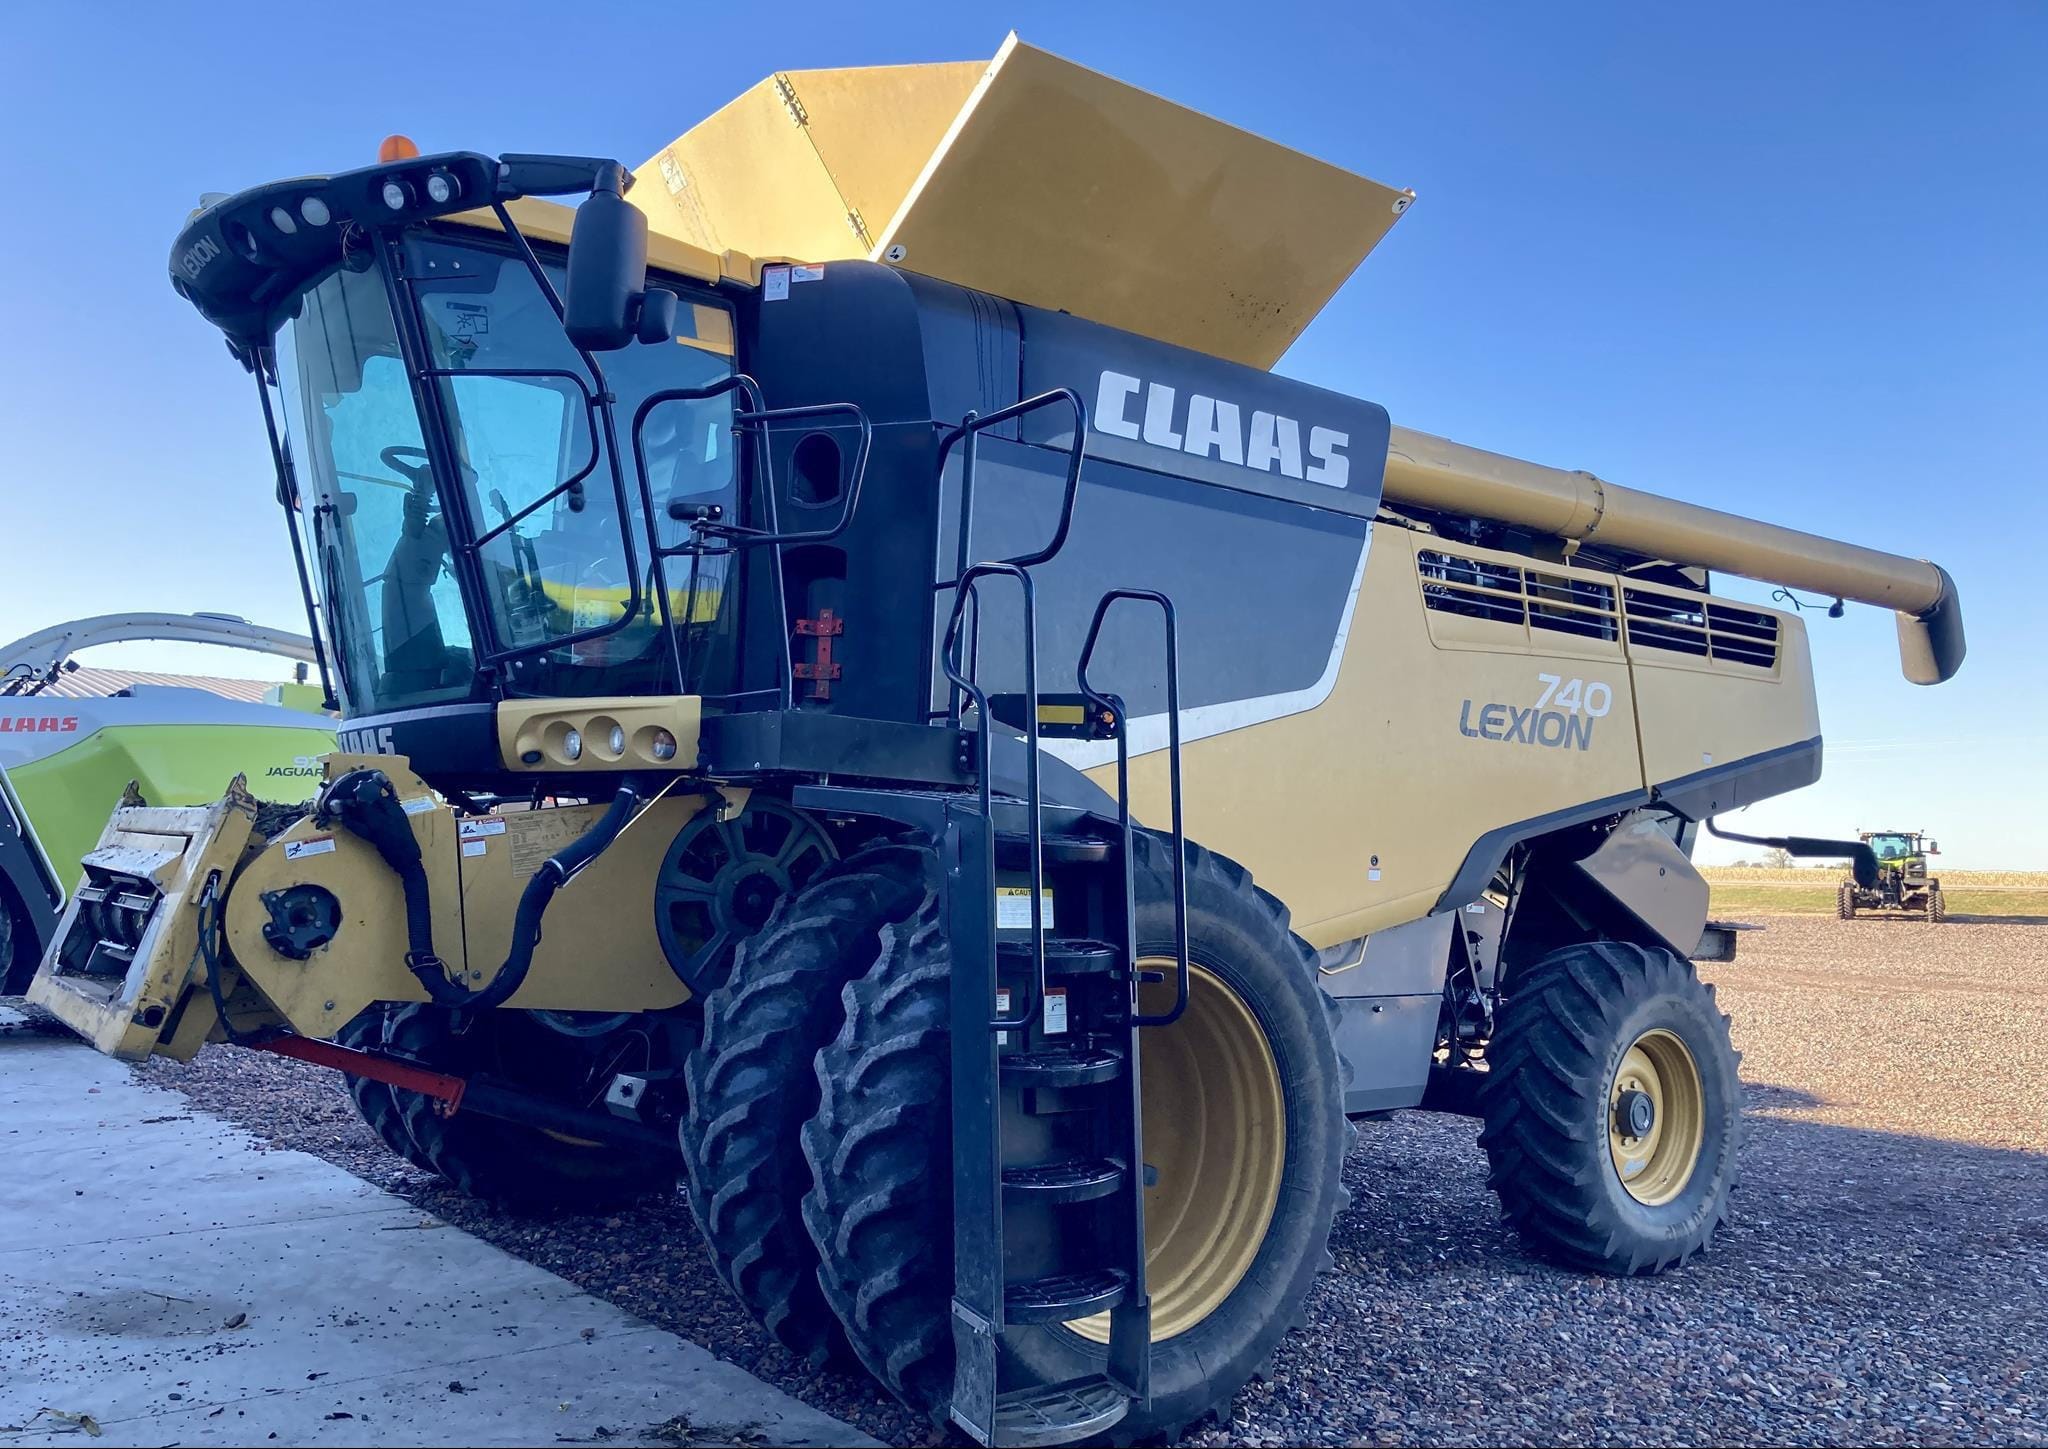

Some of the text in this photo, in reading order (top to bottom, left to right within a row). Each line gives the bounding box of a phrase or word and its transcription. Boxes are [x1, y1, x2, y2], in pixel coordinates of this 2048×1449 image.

[180, 235, 220, 279] LEXION
[1094, 370, 1350, 489] CLAAS
[1534, 672, 1613, 718] 740
[0, 717, 78, 732] LAAS
[1459, 699, 1594, 751] LEXION
[265, 767, 324, 777] JAGUAR
